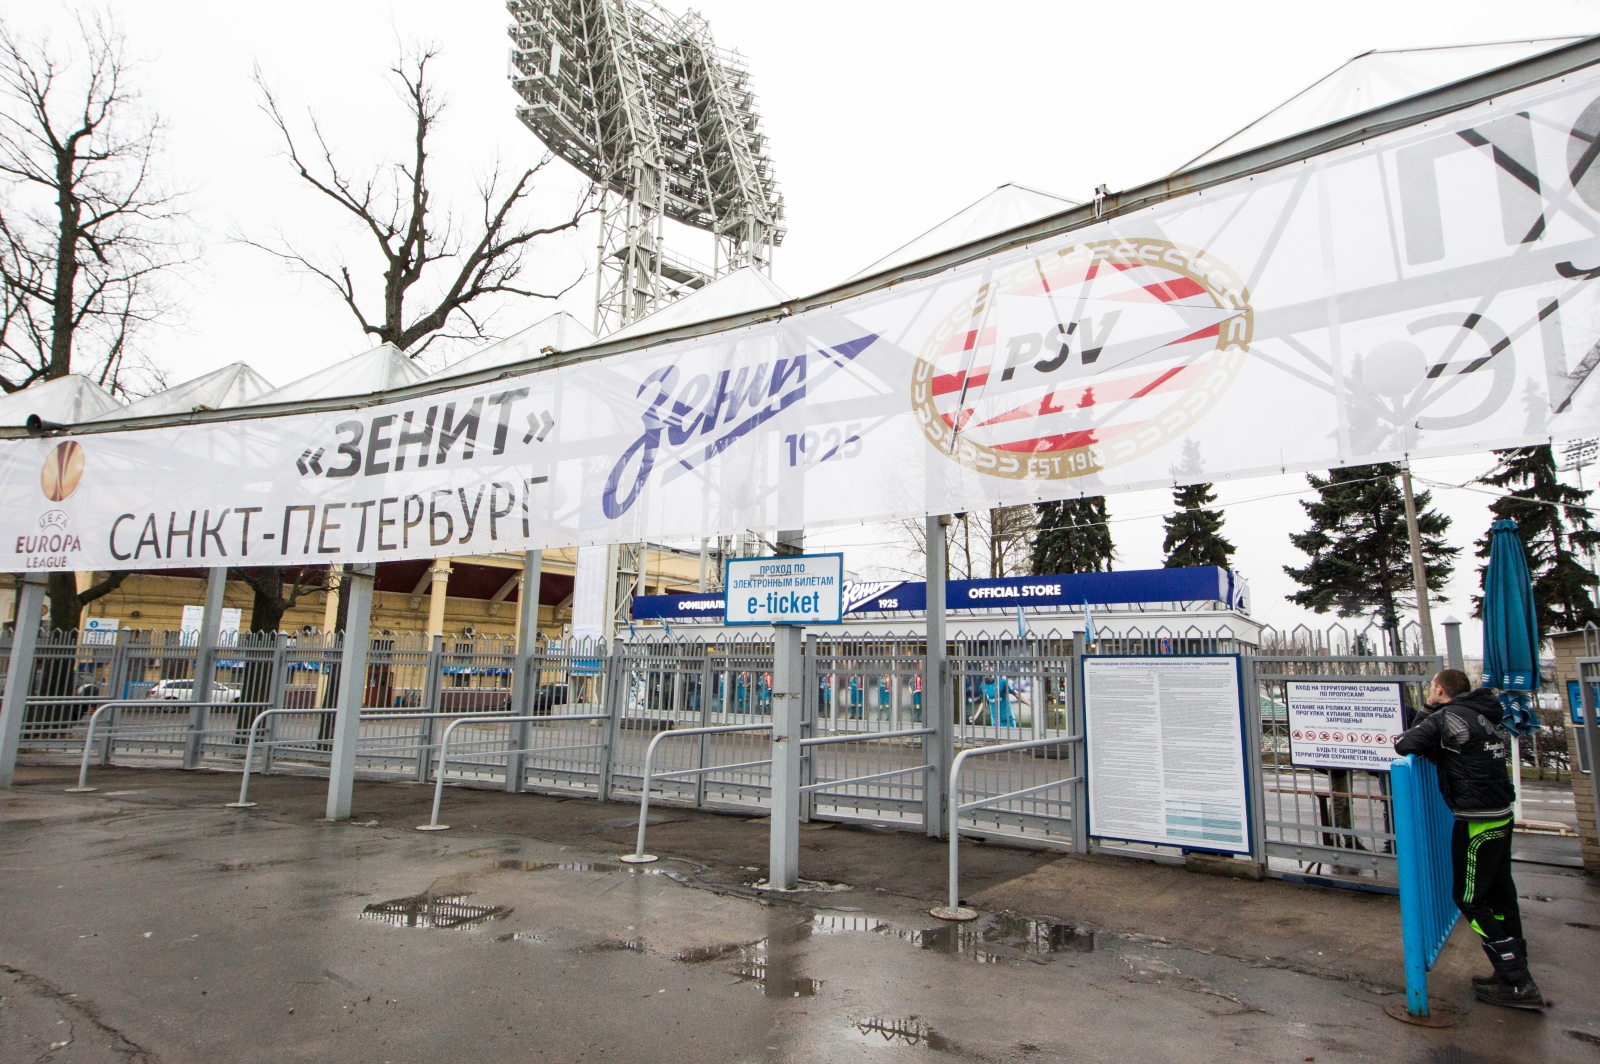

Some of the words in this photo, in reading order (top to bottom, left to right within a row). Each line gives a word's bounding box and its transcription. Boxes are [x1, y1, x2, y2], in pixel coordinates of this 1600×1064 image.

[1001, 309, 1123, 382] PSV
[296, 386, 554, 478] «ЗЕНИТ»
[785, 423, 863, 467] 1925
[1027, 456, 1062, 476] EST
[39, 513, 69, 529] UEFA
[109, 476, 548, 561] САНКТ-ПЕТЕРБУРГ
[15, 534, 82, 554] EUROPA
[26, 556, 67, 569] LEAGUE
[759, 564, 792, 575] ПРОХОД
[794, 563, 805, 573] ПО
[733, 577, 793, 589] ЭЛЕКТРОННЫМ
[794, 576, 834, 587] БИЛЕТАМ
[968, 586, 1020, 599] OFFICIAL
[1021, 584, 1062, 597] STORE
[747, 591, 820, 615] e-ticket
[878, 599, 898, 609] 1925
[1295, 751, 1330, 759] ТЕРРИТОРИЯ
[1331, 754, 1367, 762] ОХРАНЯЕТСЯ
